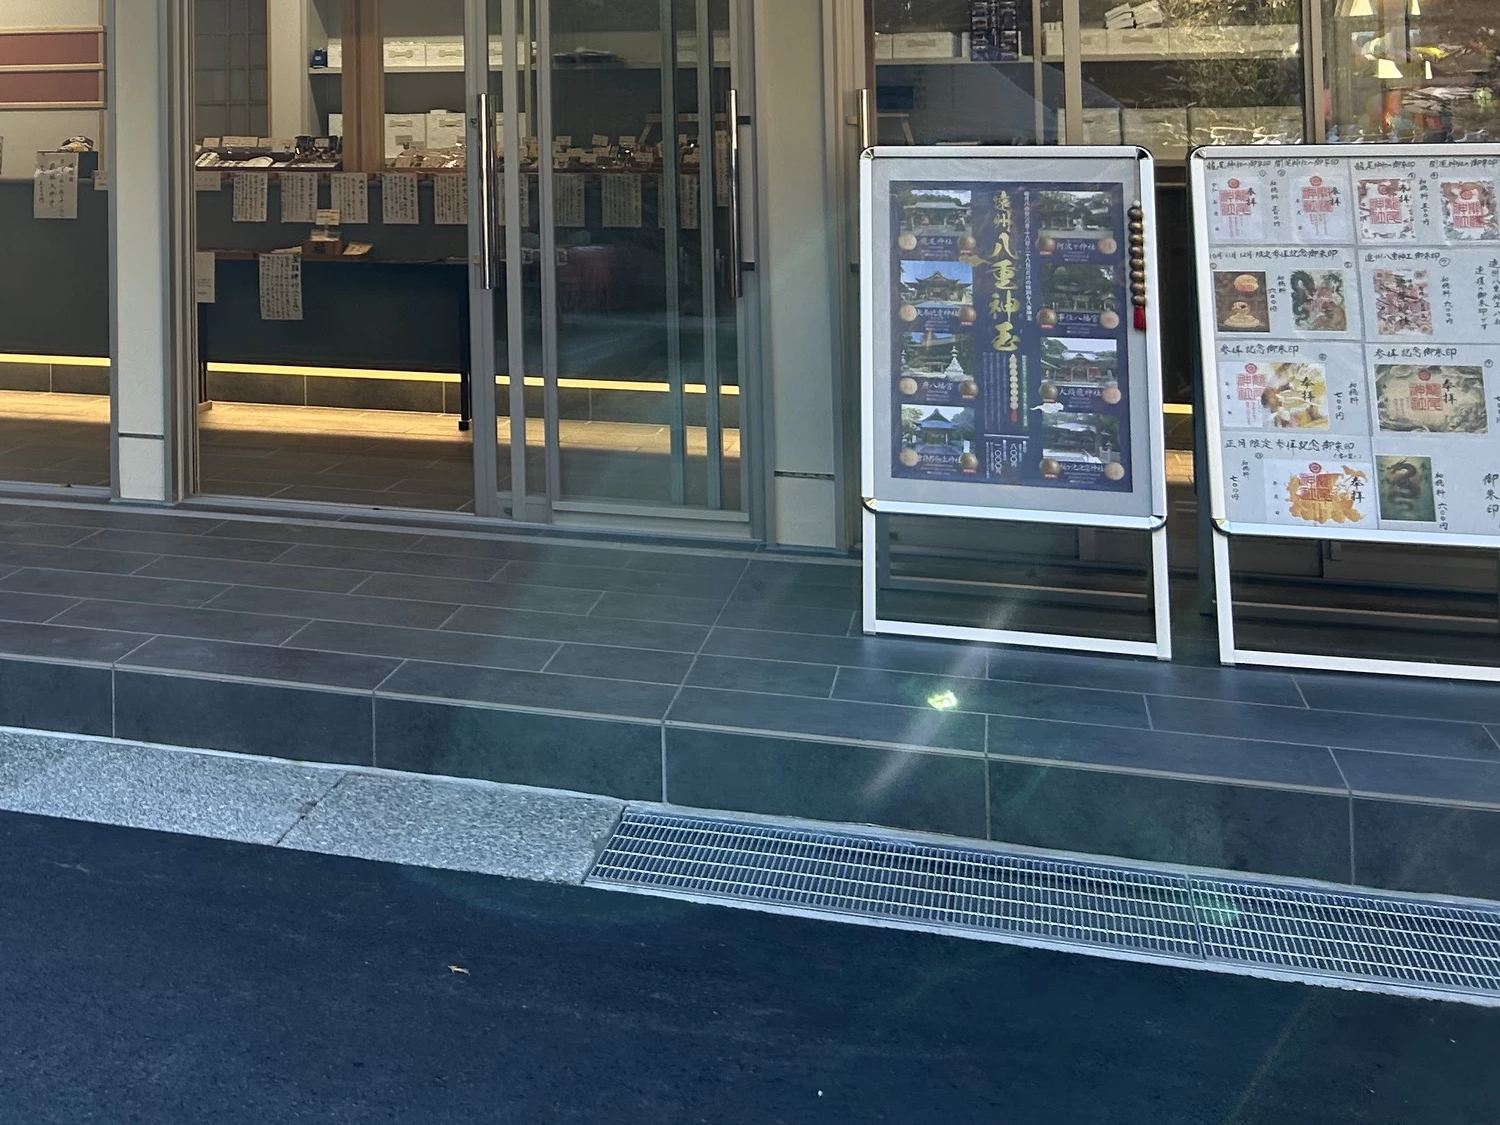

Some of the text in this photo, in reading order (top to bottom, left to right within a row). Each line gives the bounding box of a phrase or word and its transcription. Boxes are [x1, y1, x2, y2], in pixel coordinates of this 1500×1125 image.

[988, 190, 1020, 352] 遠州八重神玉
[1300, 376, 1316, 402] 奉拝
[1442, 379, 1457, 406] 奉拝
[1350, 476, 1365, 504] 奉拝
[1482, 472, 1500, 518] 御朱印
